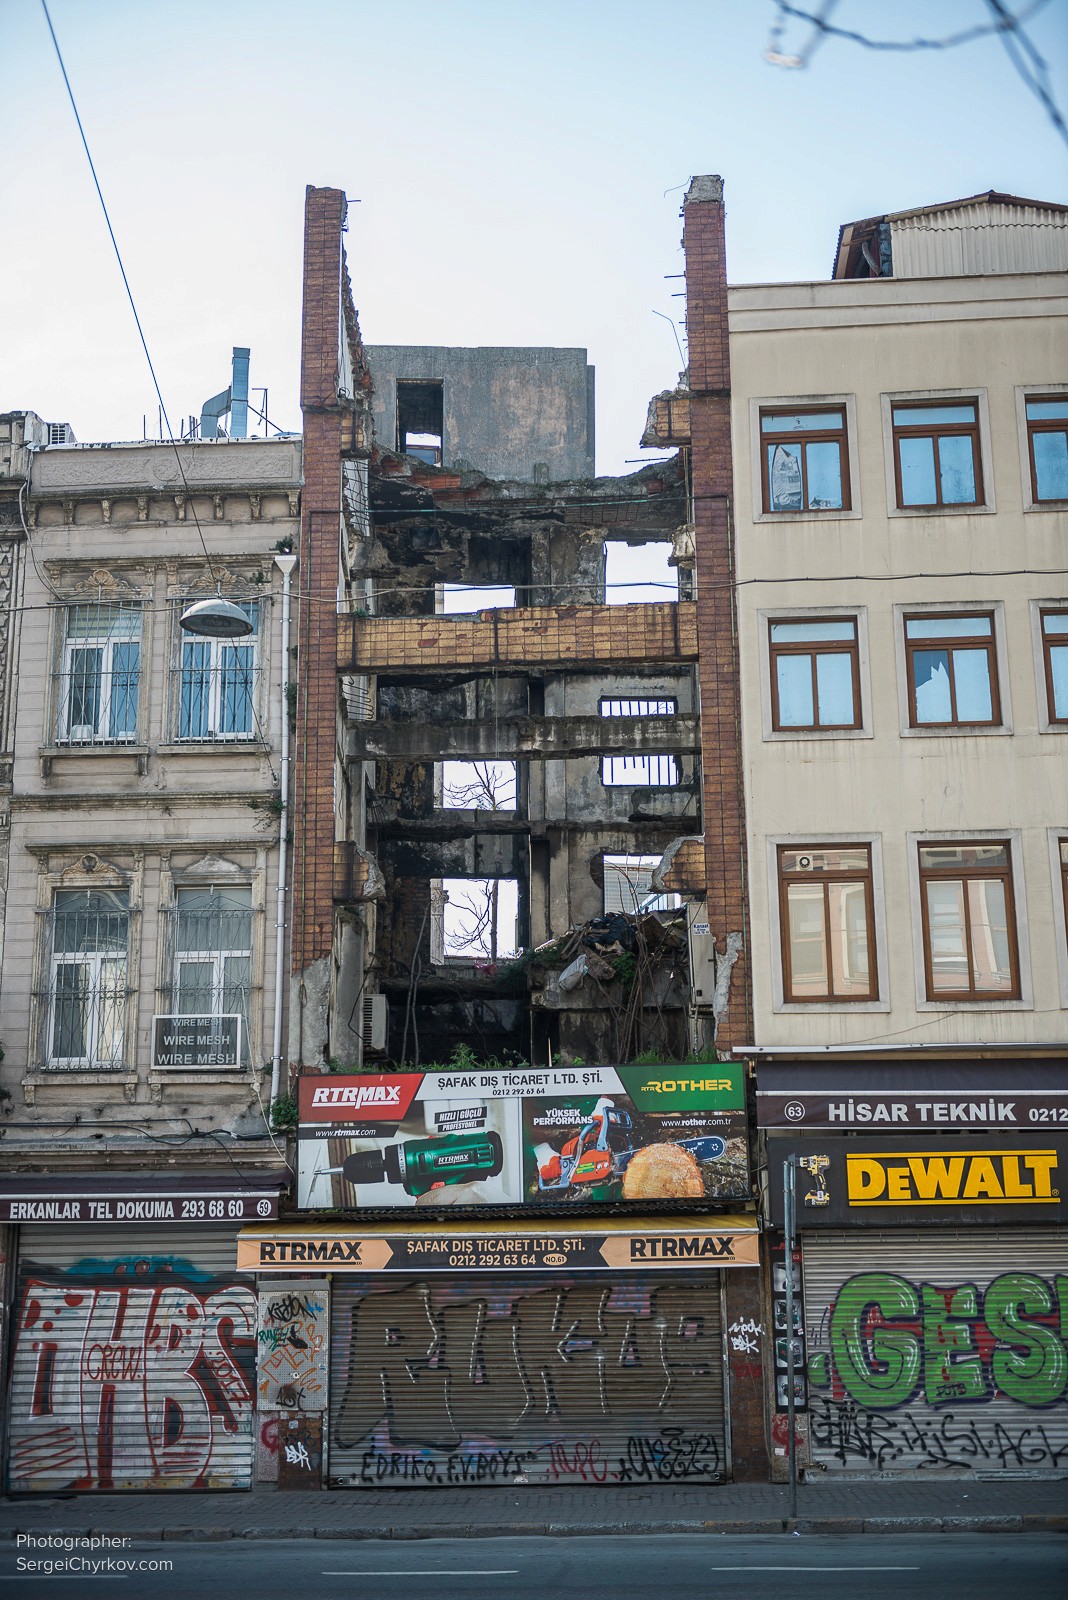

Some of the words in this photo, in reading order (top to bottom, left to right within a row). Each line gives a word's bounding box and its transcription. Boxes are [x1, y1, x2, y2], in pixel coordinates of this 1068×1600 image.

[173, 1019, 195, 1027] WIRE
[197, 1018, 222, 1027] MESH
[164, 1036, 195, 1046] WIRE
[196, 1035, 230, 1045] MESH
[157, 1054, 192, 1065] WIRE
[197, 1053, 235, 1064] MESH
[437, 1076, 477, 1090] ŞAFAK
[480, 1076, 499, 1089] DIŞ
[502, 1072, 550, 1086] TİCARET
[553, 1073, 579, 1084] LTD.
[646, 1079, 733, 1093] ROTHER
[312, 1085, 401, 1109] RTRMAX
[545, 1108, 581, 1118] YÜKSEK
[788, 1106, 802, 1117] 63
[828, 1098, 909, 1122] HİSAR
[915, 1098, 1017, 1122] TEKNİK
[1028, 1108, 1068, 1122] 0212
[533, 1116, 594, 1126] PERFORMANS
[661, 1118, 732, 1127] www.rother.com.tr
[315, 1129, 377, 1137] www.rtrmax.com
[846, 1155, 1058, 1200] DEWALT
[9, 1202, 81, 1219] ERKANLAR
[88, 1202, 113, 1218] TEL
[116, 1201, 175, 1218] DOKUMA
[181, 1200, 205, 1218] 293
[208, 1200, 225, 1217] 68
[227, 1200, 244, 1217] 60
[258, 1202, 270, 1214] 59
[259, 1241, 362, 1261] RTRMAX
[406, 1240, 449, 1254] ŞAFAK
[452, 1240, 473, 1253] DIŞ
[533, 1239, 560, 1251] LTD.
[630, 1236, 735, 1257] RTRMAX
[449, 1254, 476, 1266] 0212
[479, 1254, 500, 1266] 292
[503, 1254, 518, 1265] 63
[520, 1253, 537, 1265] 64
